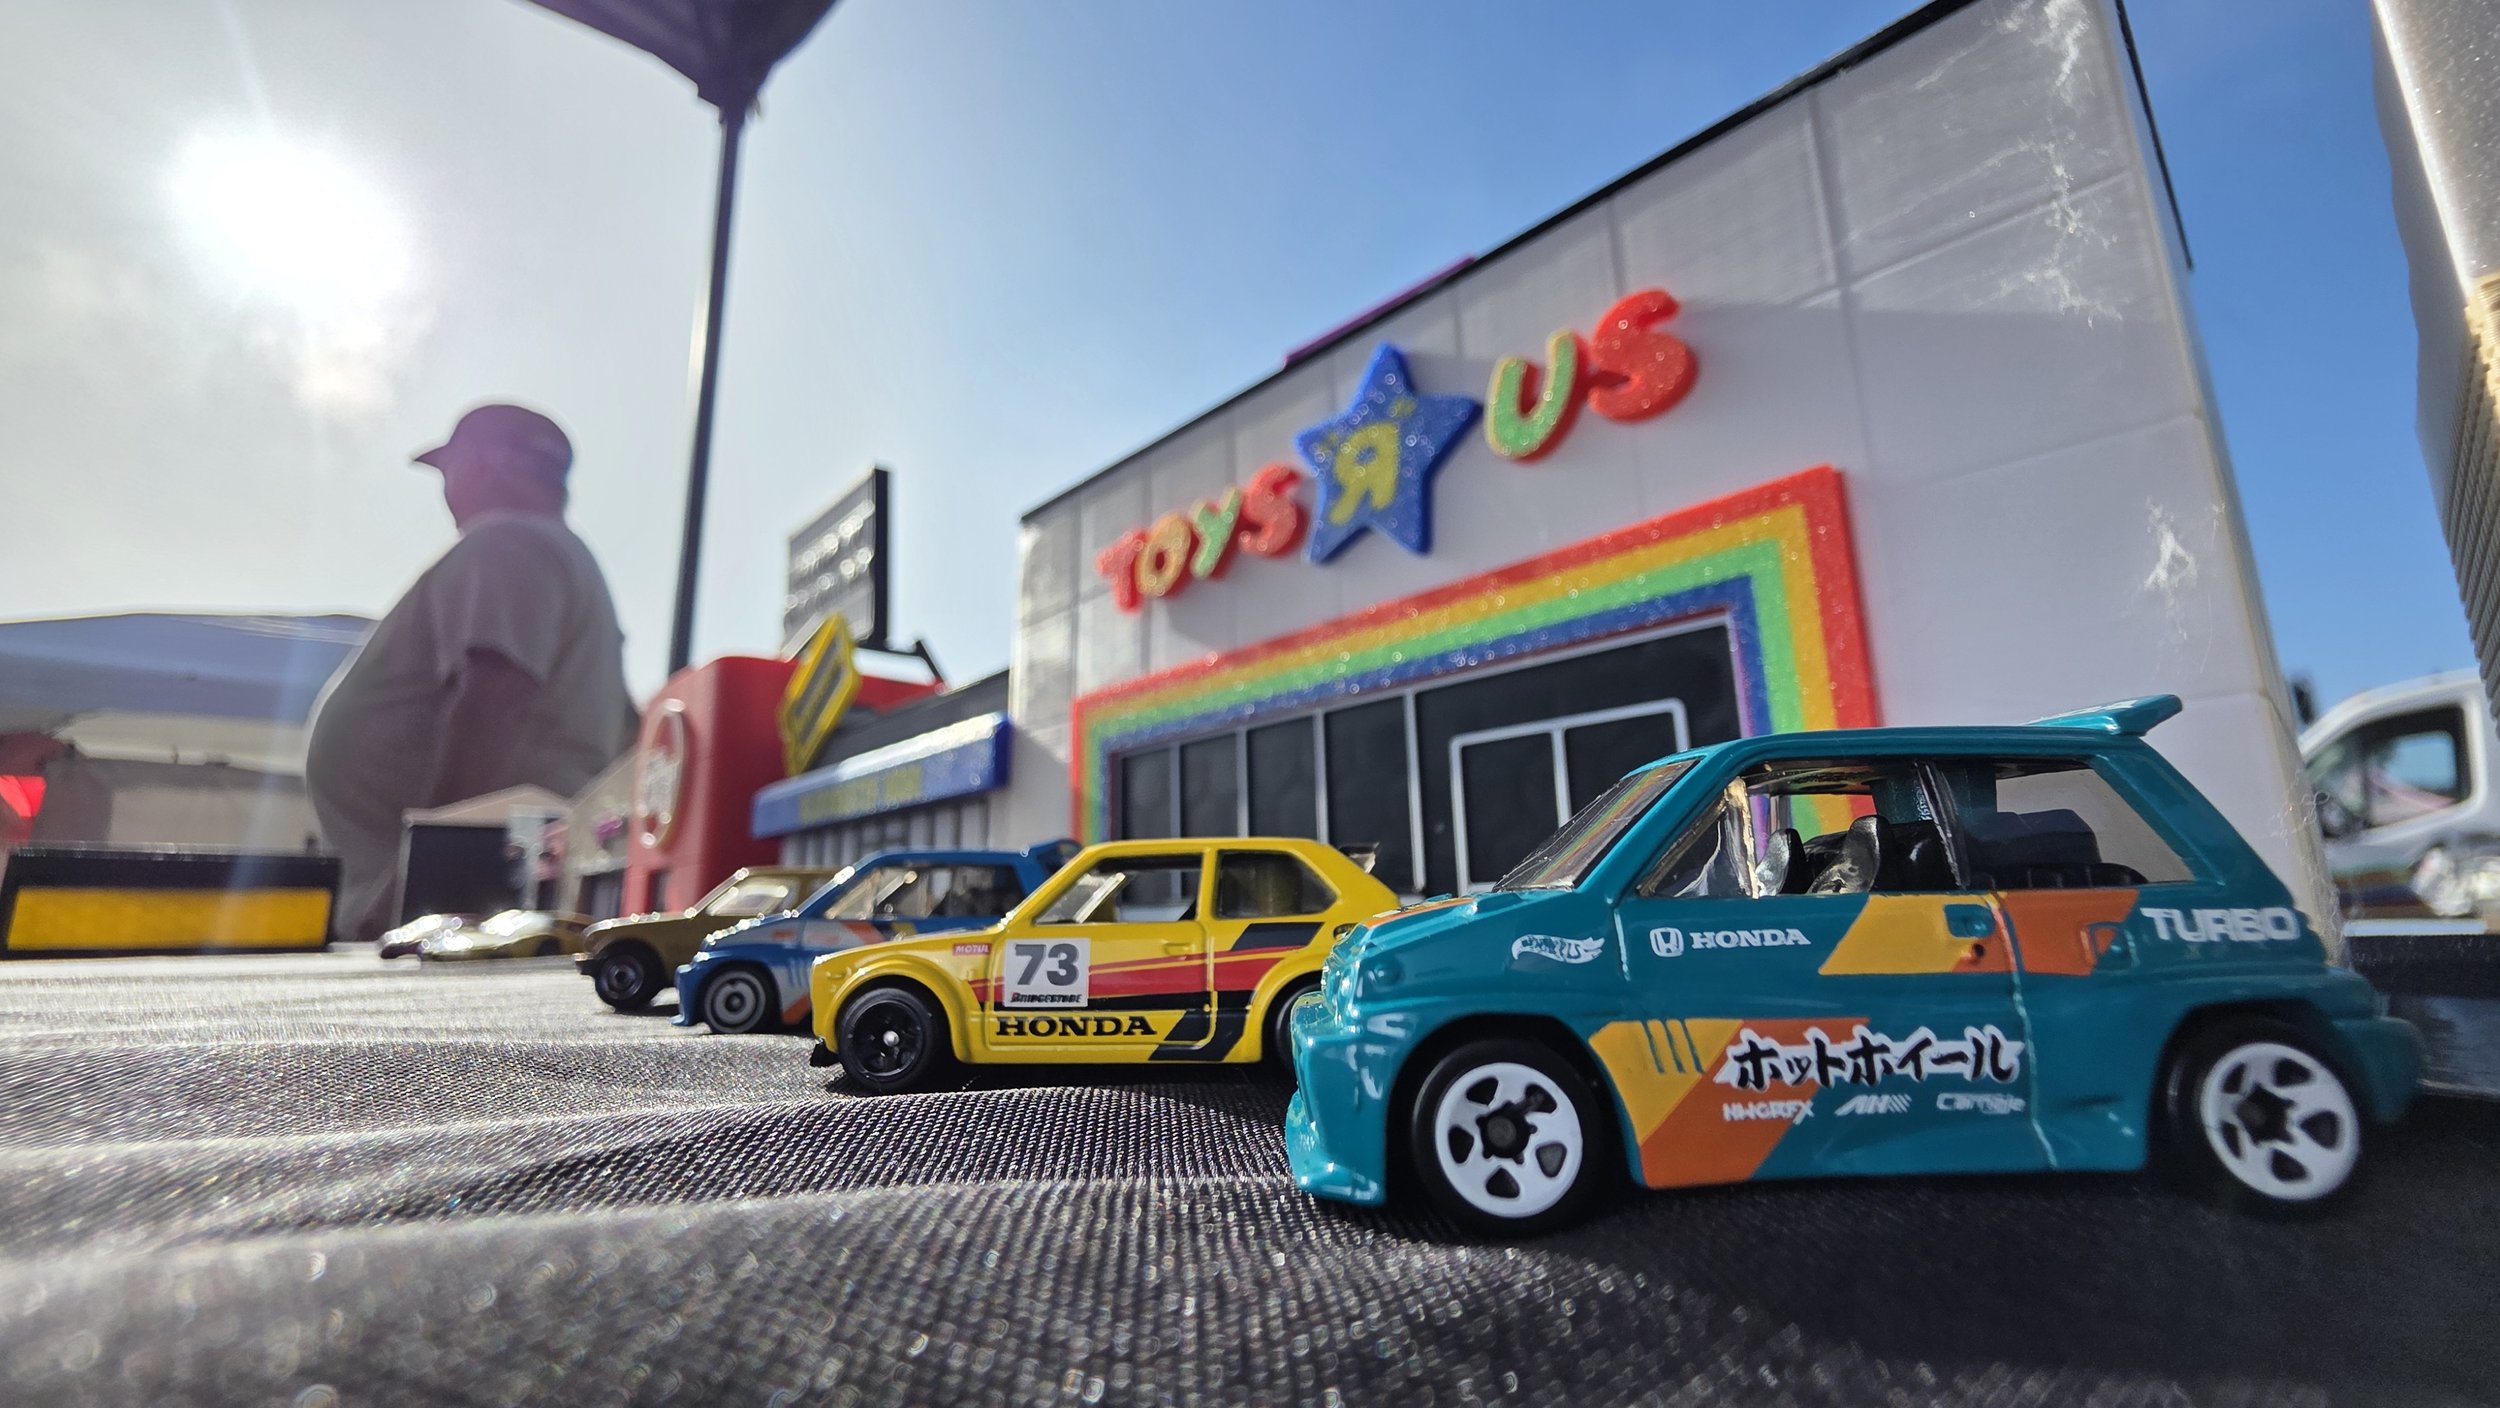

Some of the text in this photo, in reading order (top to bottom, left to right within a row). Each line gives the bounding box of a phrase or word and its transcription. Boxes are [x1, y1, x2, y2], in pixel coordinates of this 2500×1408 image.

[1096, 463, 1303, 613] TOYS
[1486, 288, 1698, 462] US
[1690, 929, 1811, 949] HONDA
[2140, 907, 2300, 942] TURBO
[955, 944, 990, 954] MOTUL
[1014, 943, 1080, 987] 73
[996, 1016, 1157, 1037] HONDA
[1728, 1030, 2018, 1091] ホットホイール
